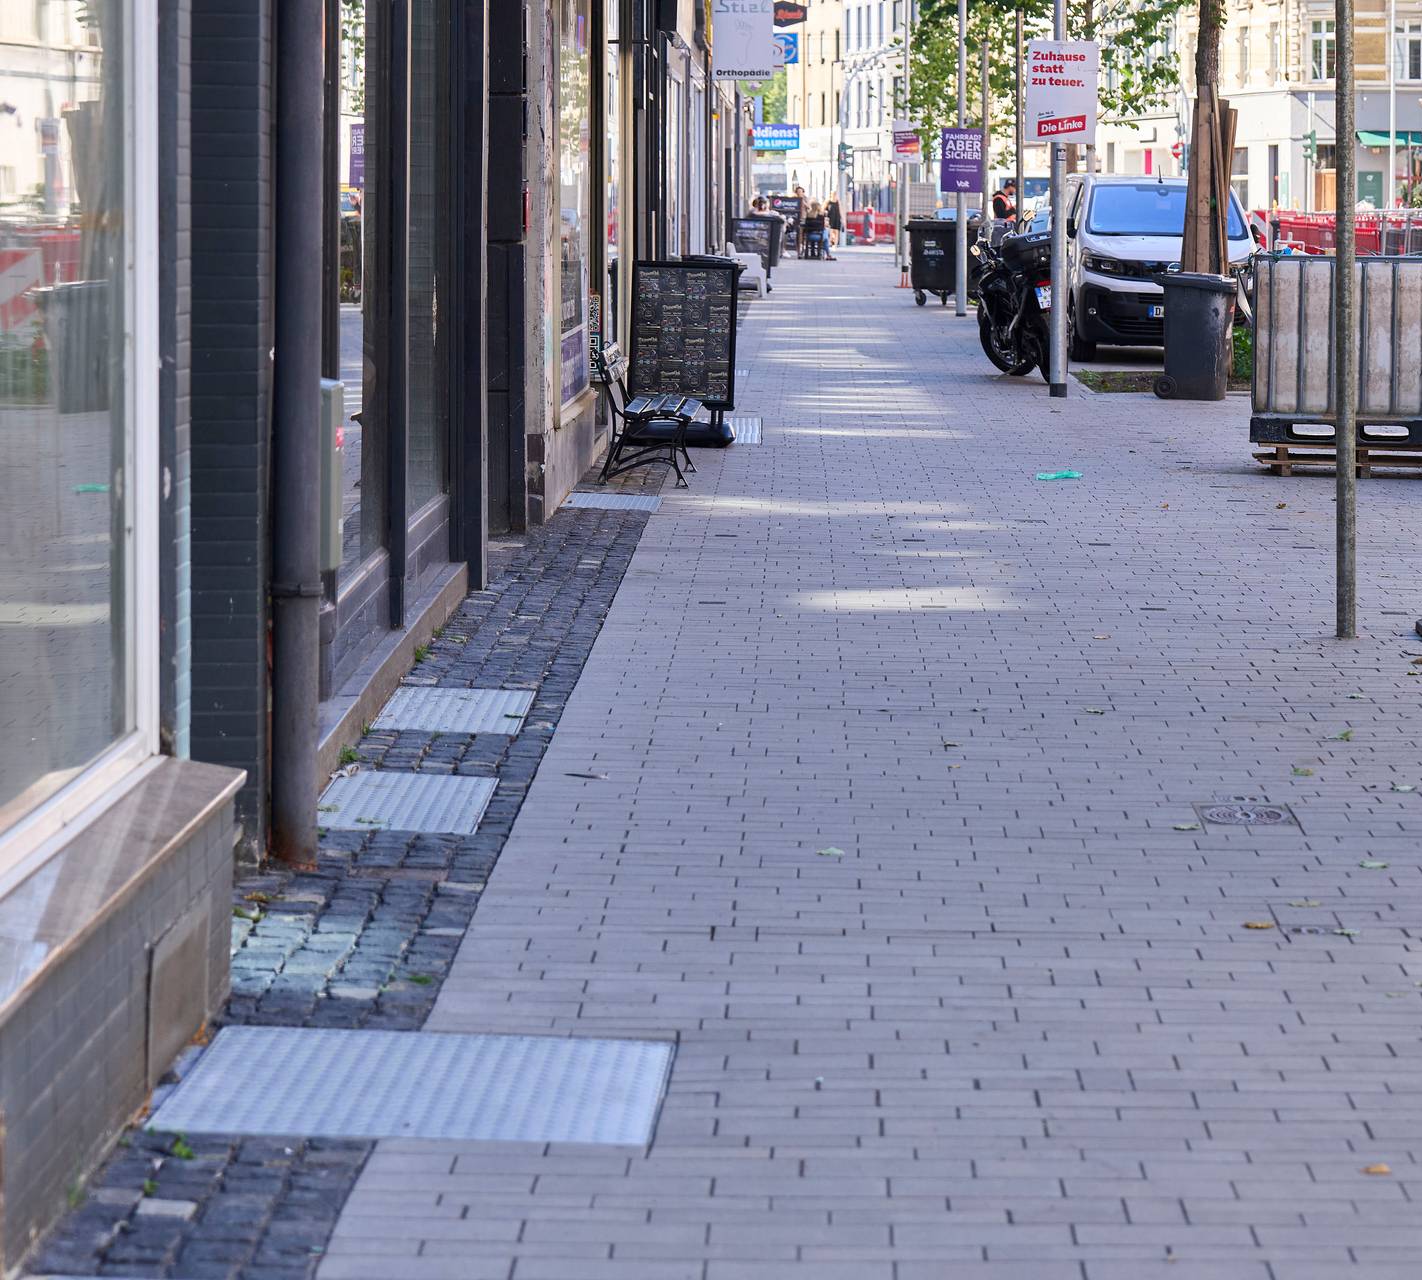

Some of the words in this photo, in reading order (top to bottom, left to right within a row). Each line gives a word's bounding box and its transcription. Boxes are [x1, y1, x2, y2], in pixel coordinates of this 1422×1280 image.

[1032, 50, 1086, 62] Zuhause
[716, 69, 771, 77] Orthopädie
[1032, 63, 1064, 74] statt
[1031, 77, 1046, 86] zu
[1048, 76, 1085, 87] teuer.
[1040, 123, 1057, 133] Die
[1058, 119, 1083, 131] Linke
[945, 133, 982, 141] FAHRRAD?
[945, 140, 982, 151] ABER
[945, 151, 982, 160] SICHER!
[956, 180, 970, 188] Volt
[1155, 307, 1161, 316] D
